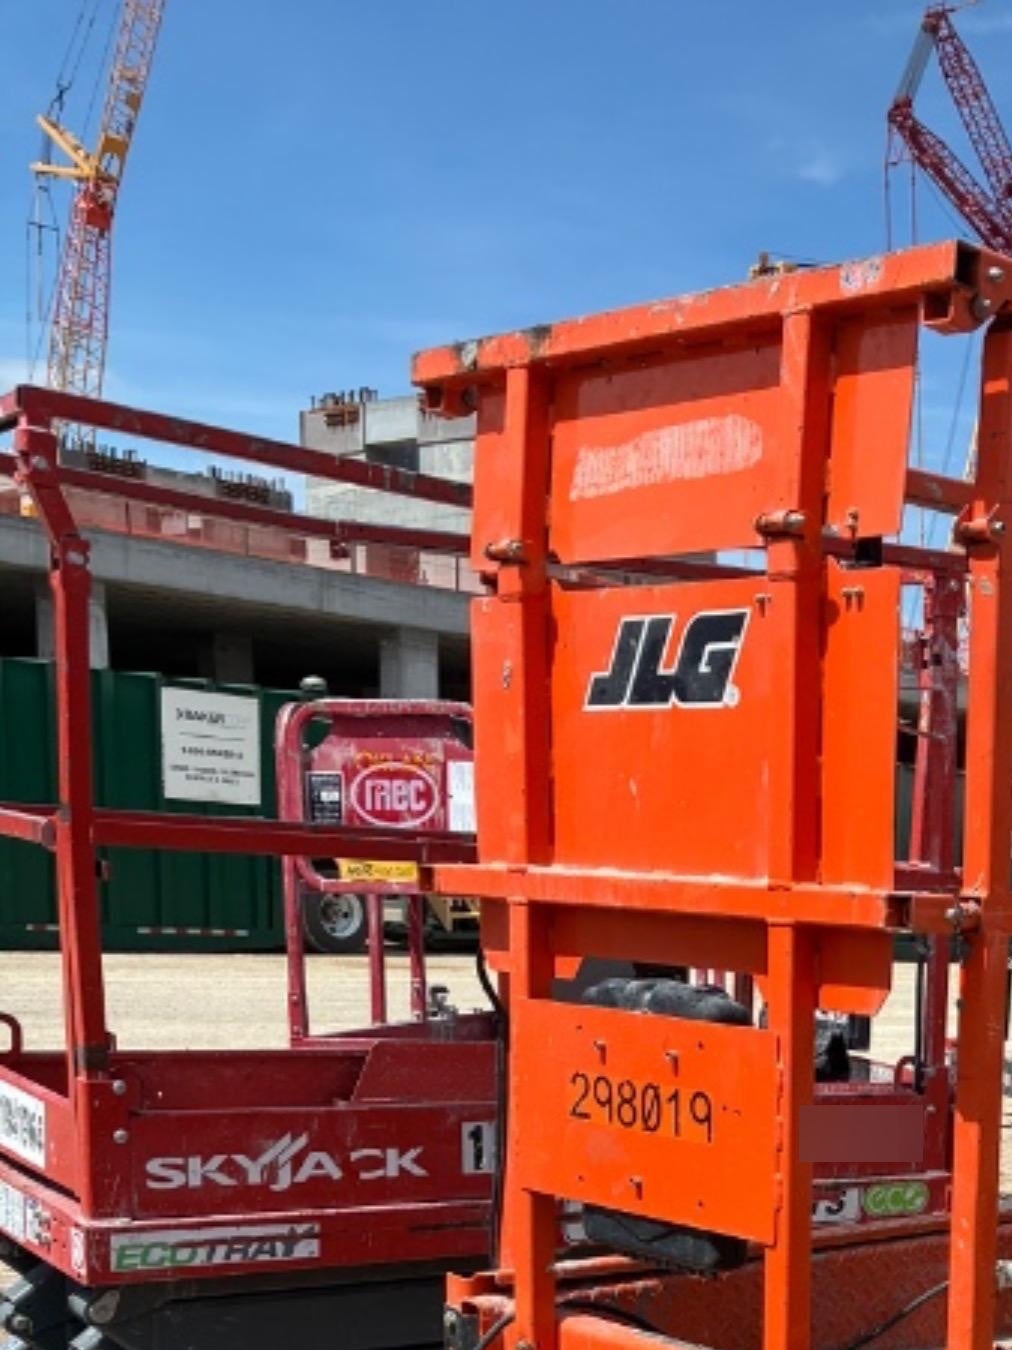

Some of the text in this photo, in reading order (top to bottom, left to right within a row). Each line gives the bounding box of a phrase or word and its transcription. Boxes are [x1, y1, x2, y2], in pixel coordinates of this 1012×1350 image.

[583, 609, 752, 712] JLG
[568, 1073, 713, 1144] 298019
[145, 1131, 430, 1192] SKYJACK
